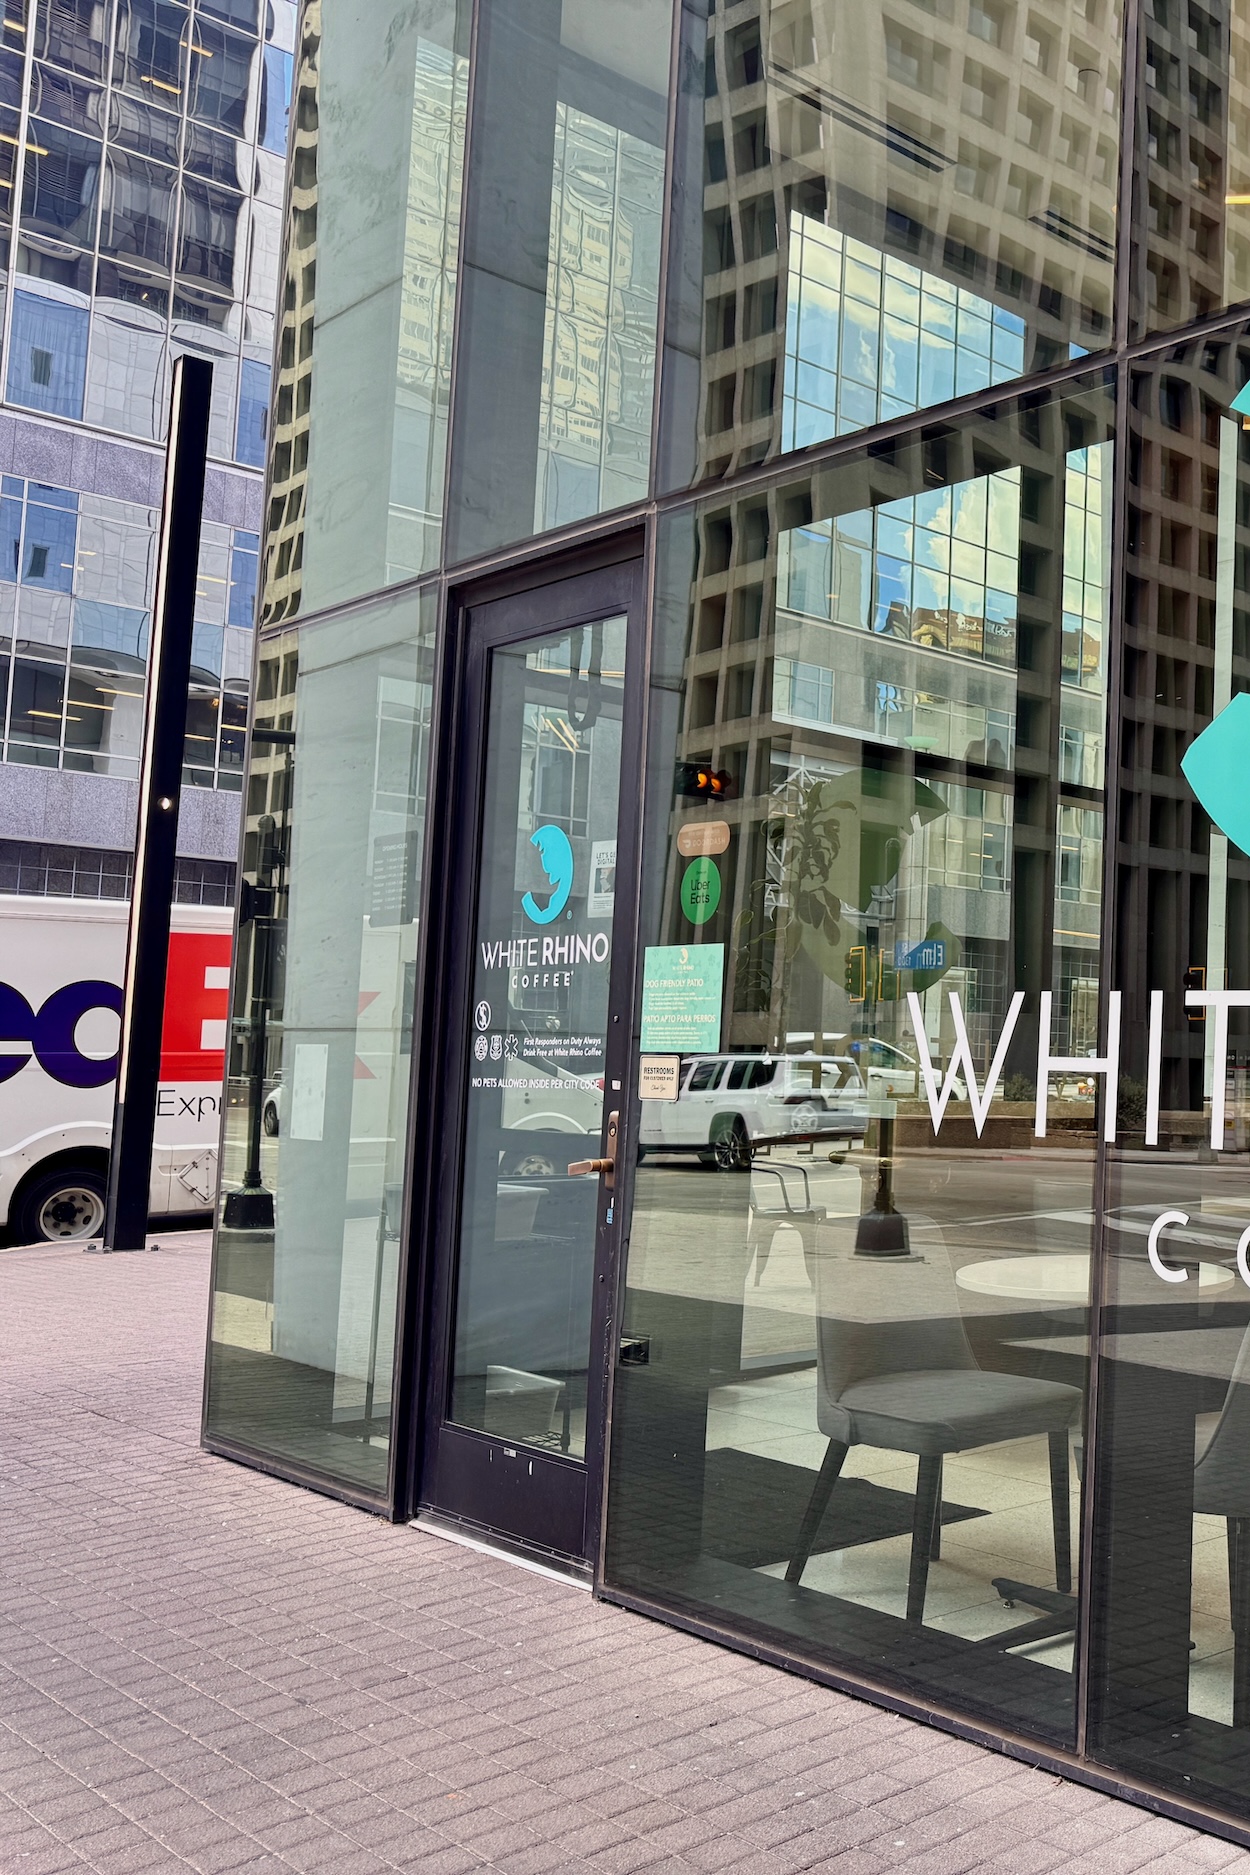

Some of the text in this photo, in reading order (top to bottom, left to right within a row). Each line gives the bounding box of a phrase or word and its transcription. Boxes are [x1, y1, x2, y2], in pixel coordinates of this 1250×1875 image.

[690, 879, 711, 891] Uber
[690, 892, 710, 905] Eats
[481, 932, 609, 970] WHITE RHINO
[511, 972, 571, 989] COFFEE
[644, 978, 704, 988] DOG FRIENDLY PATIO
[643, 1014, 716, 1023] PATIO APTO PARA PERROS
[523, 1037, 535, 1045] First
[535, 1037, 563, 1047] Responders
[570, 1037, 583, 1047] Duty
[583, 1036, 602, 1047] Always
[523, 1047, 603, 1057] Drink Free at White Rhino Coffee
[643, 1067, 675, 1075] RESTROOMS
[472, 1077, 600, 1090] NO PETS ALLOWED INSIDE PER CITY CODE
[156, 1089, 223, 1122] Exp
